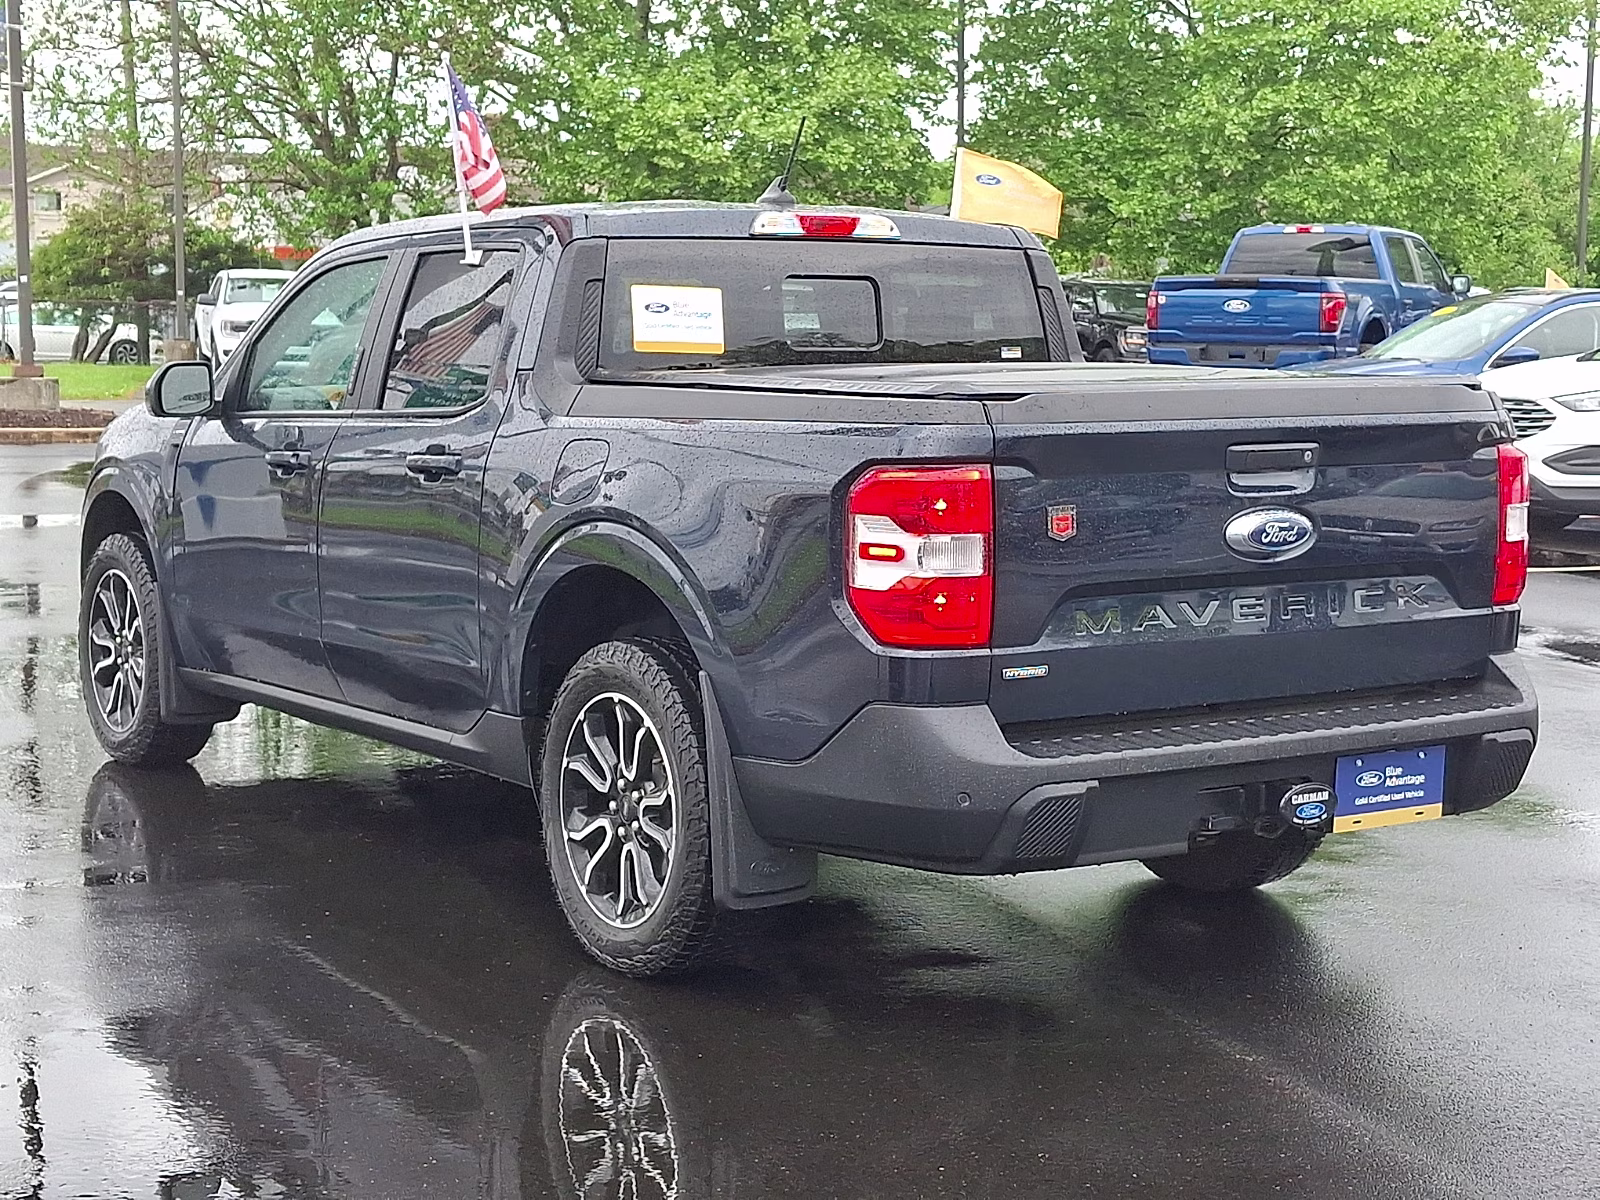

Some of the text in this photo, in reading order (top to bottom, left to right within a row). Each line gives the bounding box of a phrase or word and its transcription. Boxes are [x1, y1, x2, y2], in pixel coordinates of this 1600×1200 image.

[1262, 521, 1298, 543] Ford
[1075, 583, 1430, 636] MAVERICK
[1005, 668, 1047, 677] HYBRID
[1360, 766, 1404, 785] Ford Blue
[1384, 774, 1426, 788] Advantage
